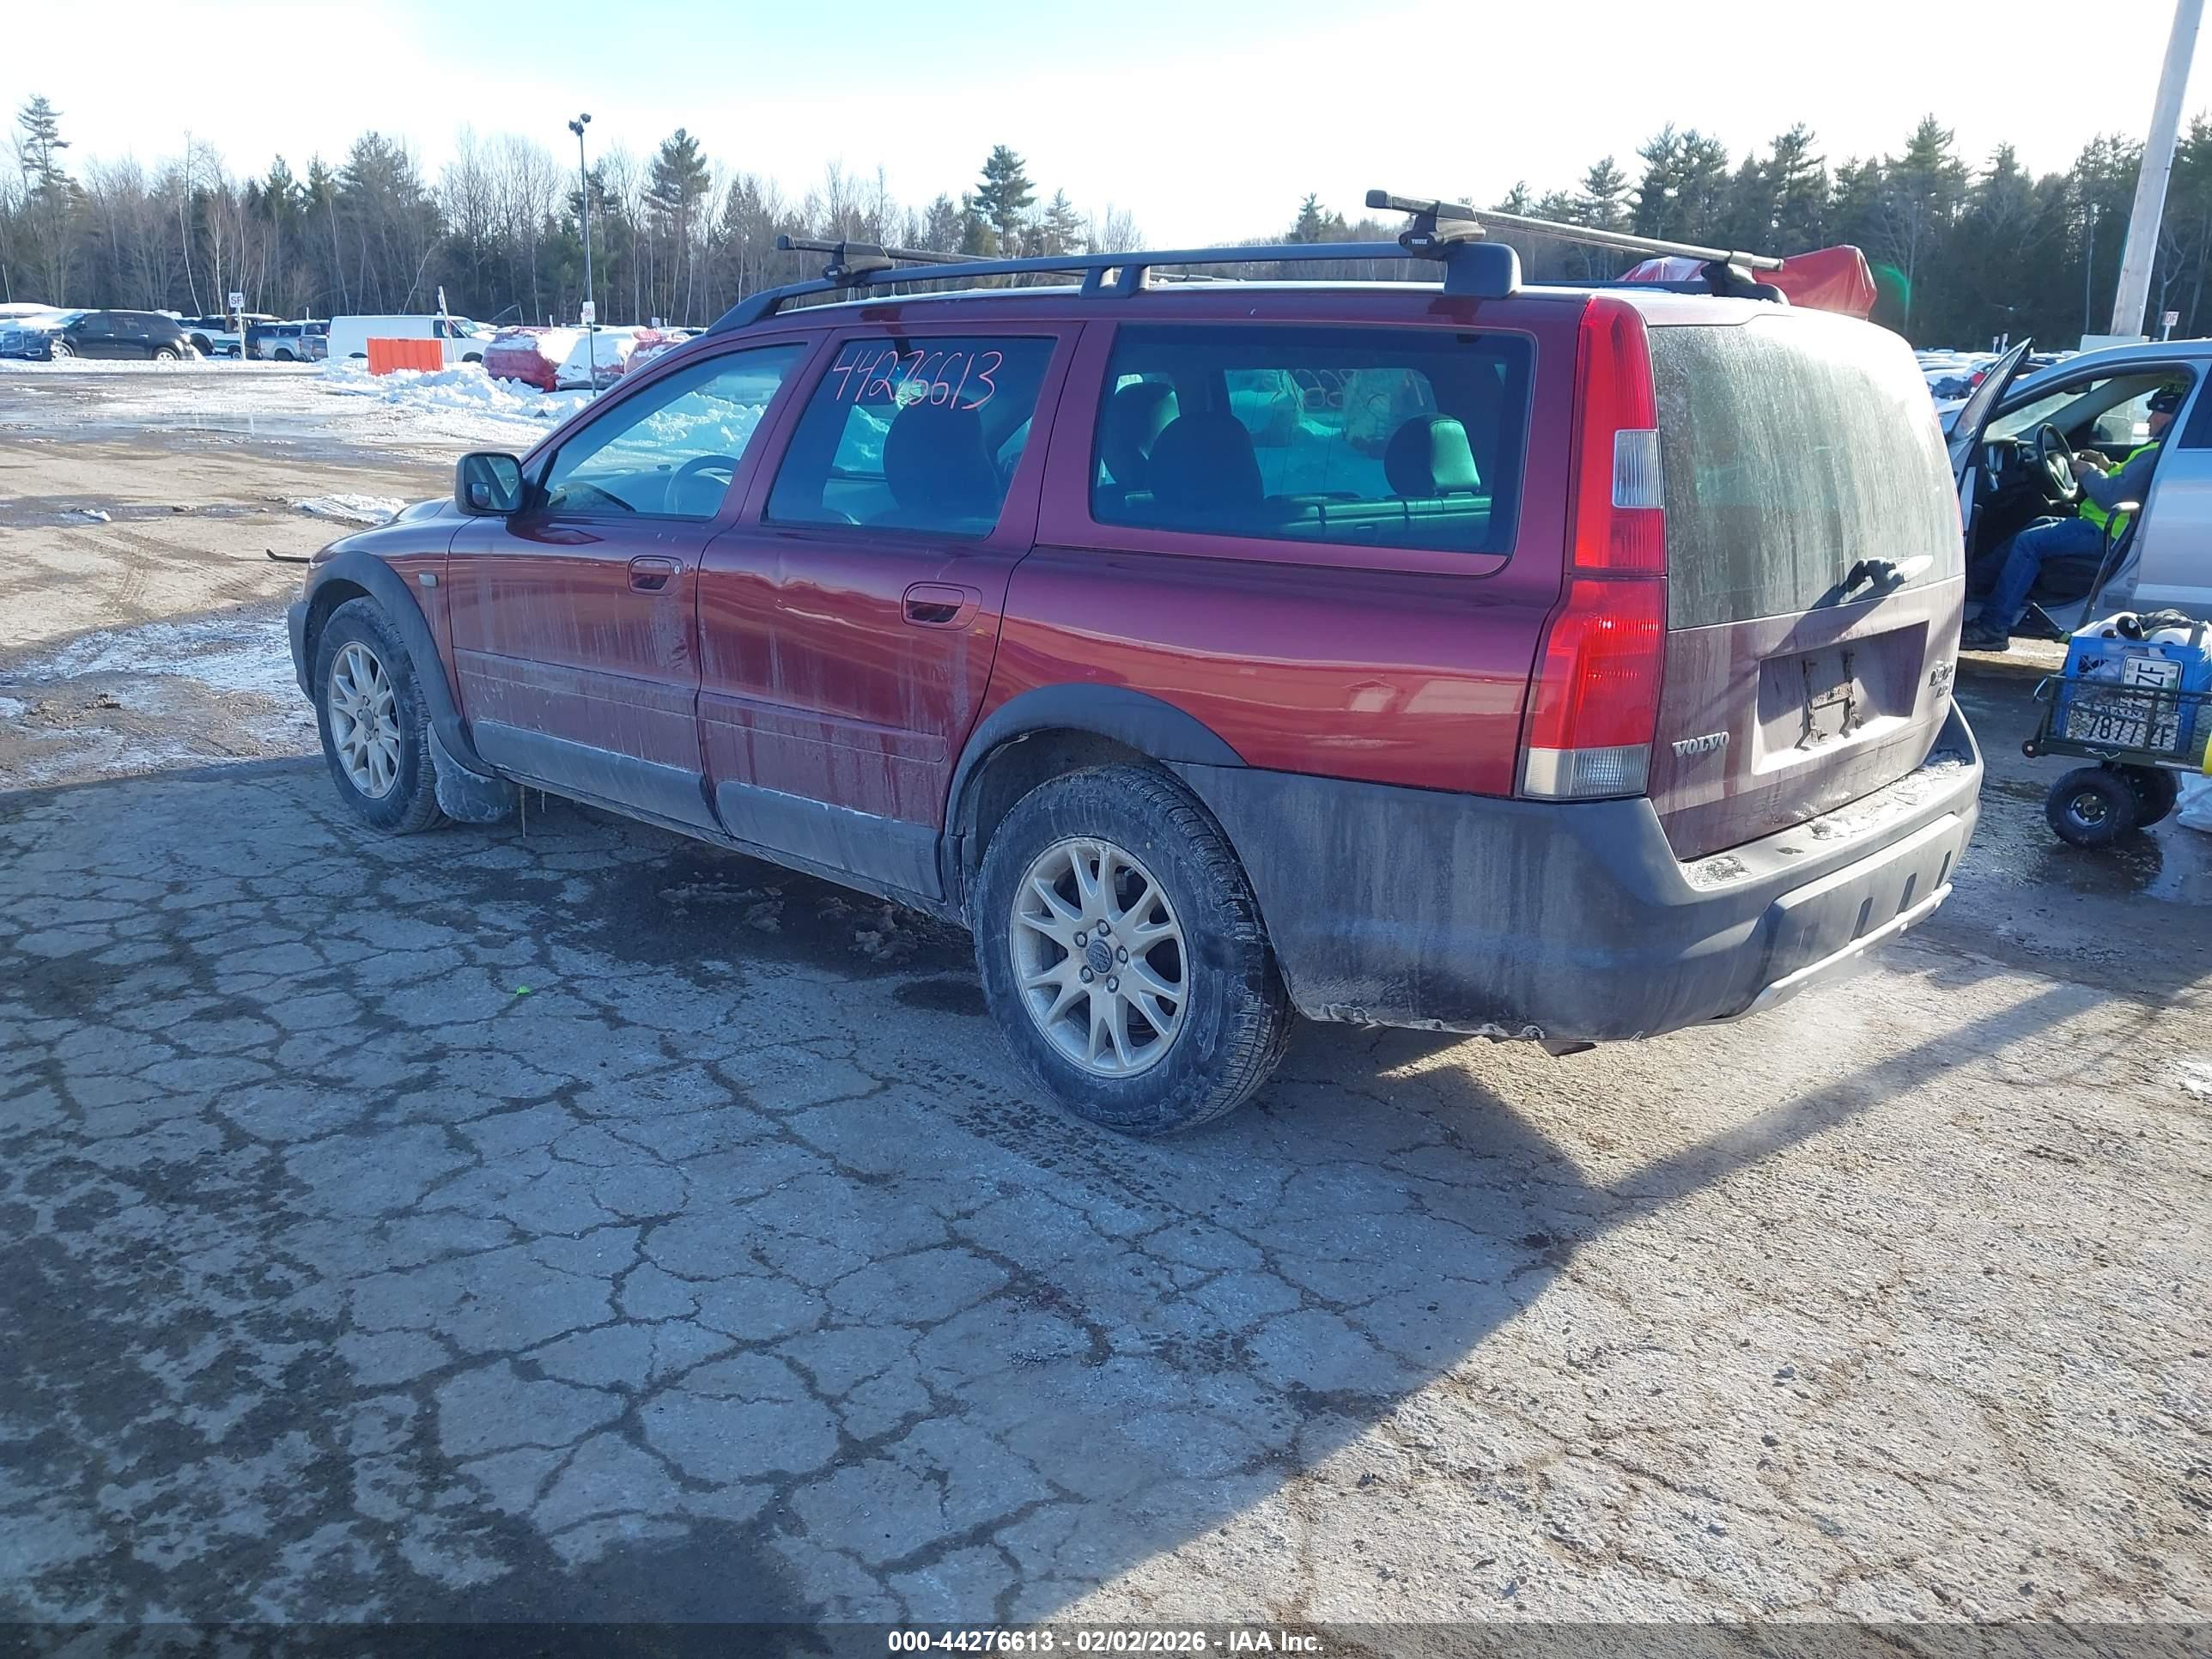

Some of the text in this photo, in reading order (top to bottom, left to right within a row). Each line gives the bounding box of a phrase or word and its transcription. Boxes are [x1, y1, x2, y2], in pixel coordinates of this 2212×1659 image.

[230, 295, 242, 305] SF
[832, 348, 1003, 410] 44276613
[1671, 731, 1730, 757] VOLVO
